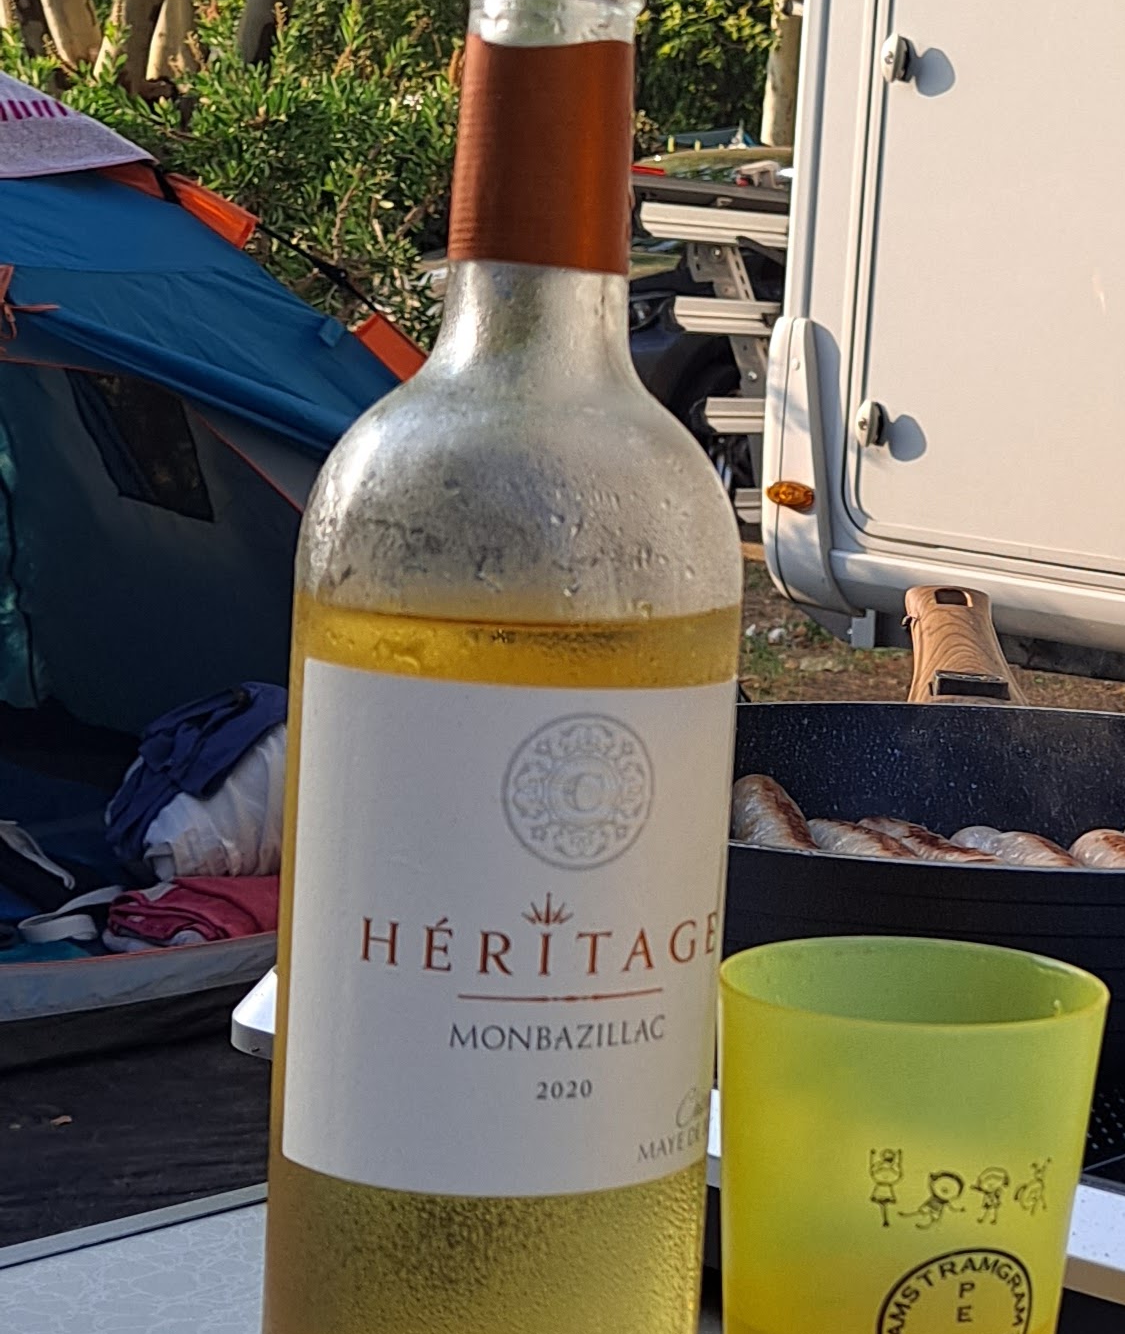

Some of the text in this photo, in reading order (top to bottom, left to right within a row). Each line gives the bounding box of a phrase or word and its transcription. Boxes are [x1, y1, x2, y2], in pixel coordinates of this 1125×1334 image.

[360, 910, 718, 977] HÉRITAGE
[449, 1014, 666, 1052] MONBAZILLAC
[536, 1079, 593, 1100] 2020
